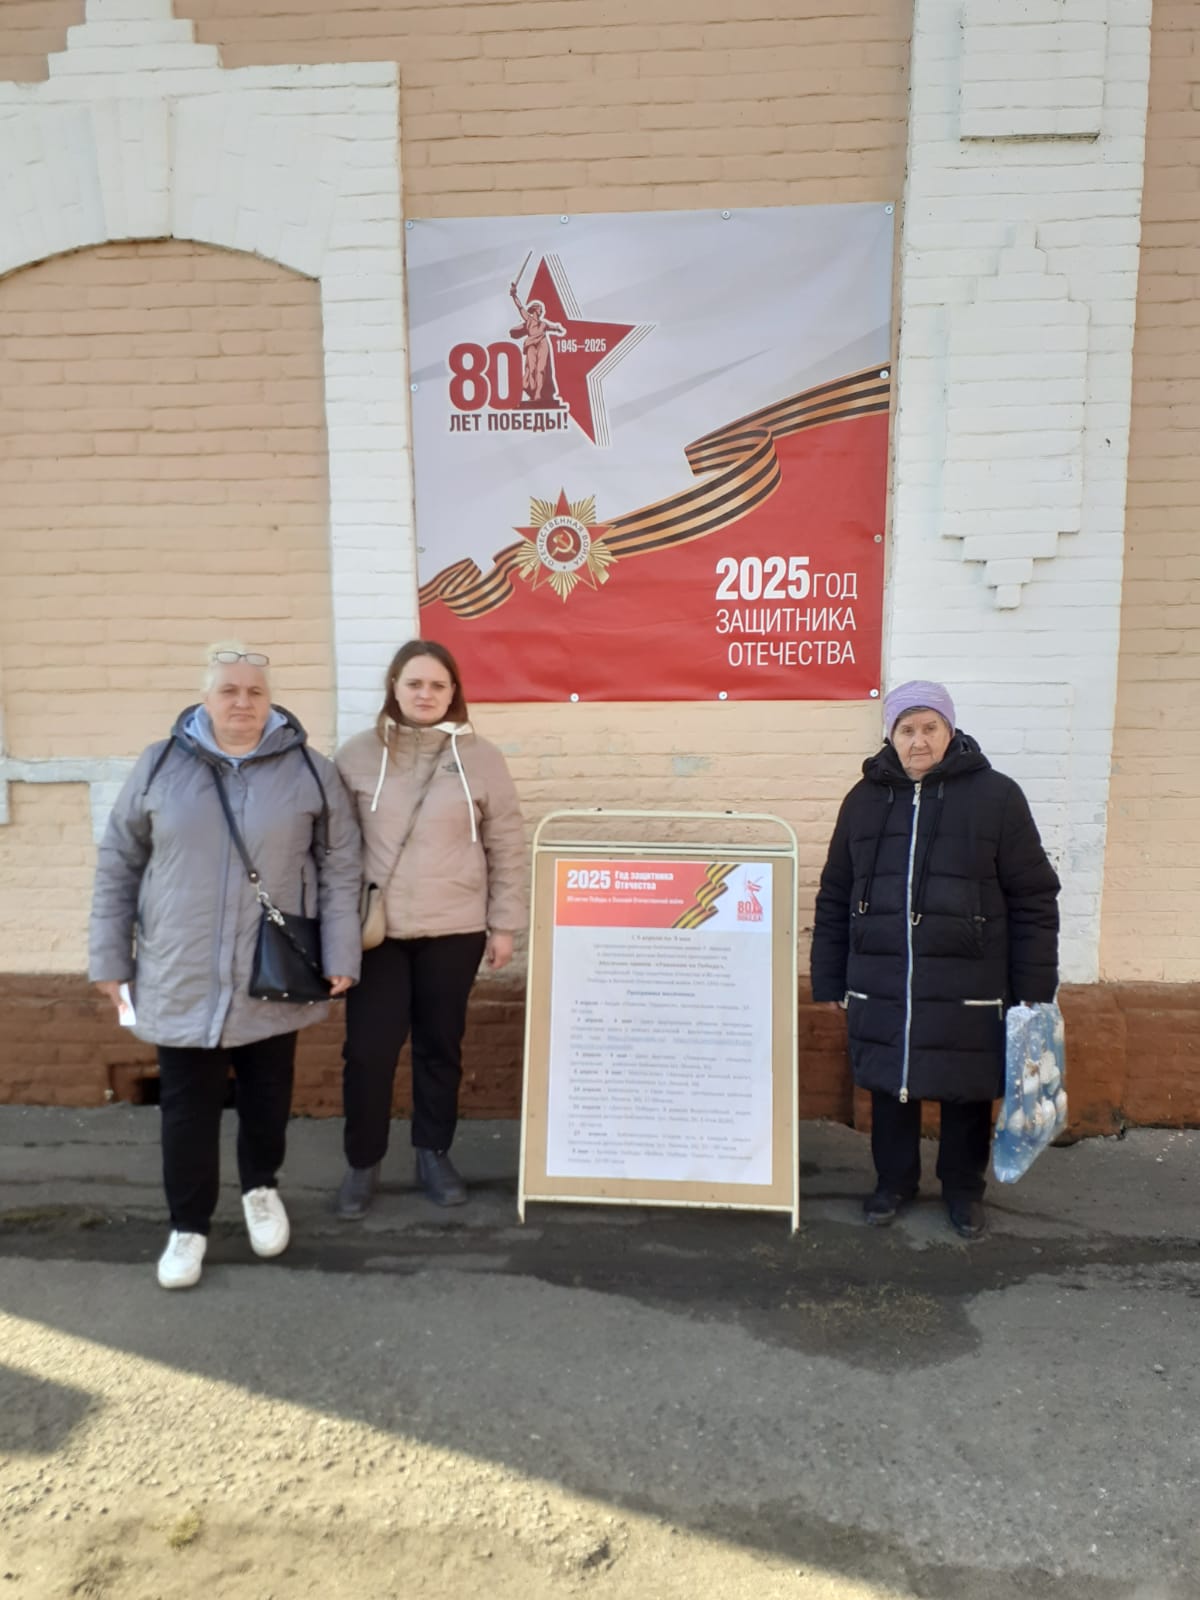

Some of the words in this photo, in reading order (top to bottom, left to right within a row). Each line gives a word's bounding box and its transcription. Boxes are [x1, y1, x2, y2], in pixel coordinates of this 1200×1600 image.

[448, 342, 523, 411] 80
[450, 413, 482, 432] ЛЕТ
[488, 412, 568, 432] ПОБЕДЫ!
[538, 517, 585, 567] ОТЕЧЕСТВЕННАЯ
[715, 556, 811, 600] 2025
[813, 572, 857, 600] ГОД
[715, 607, 857, 636] ЗАЩИТНИКА
[728, 640, 856, 667] ОТЕЧЕСТВА
[566, 870, 611, 890] 2025
[737, 900, 751, 913] 80
